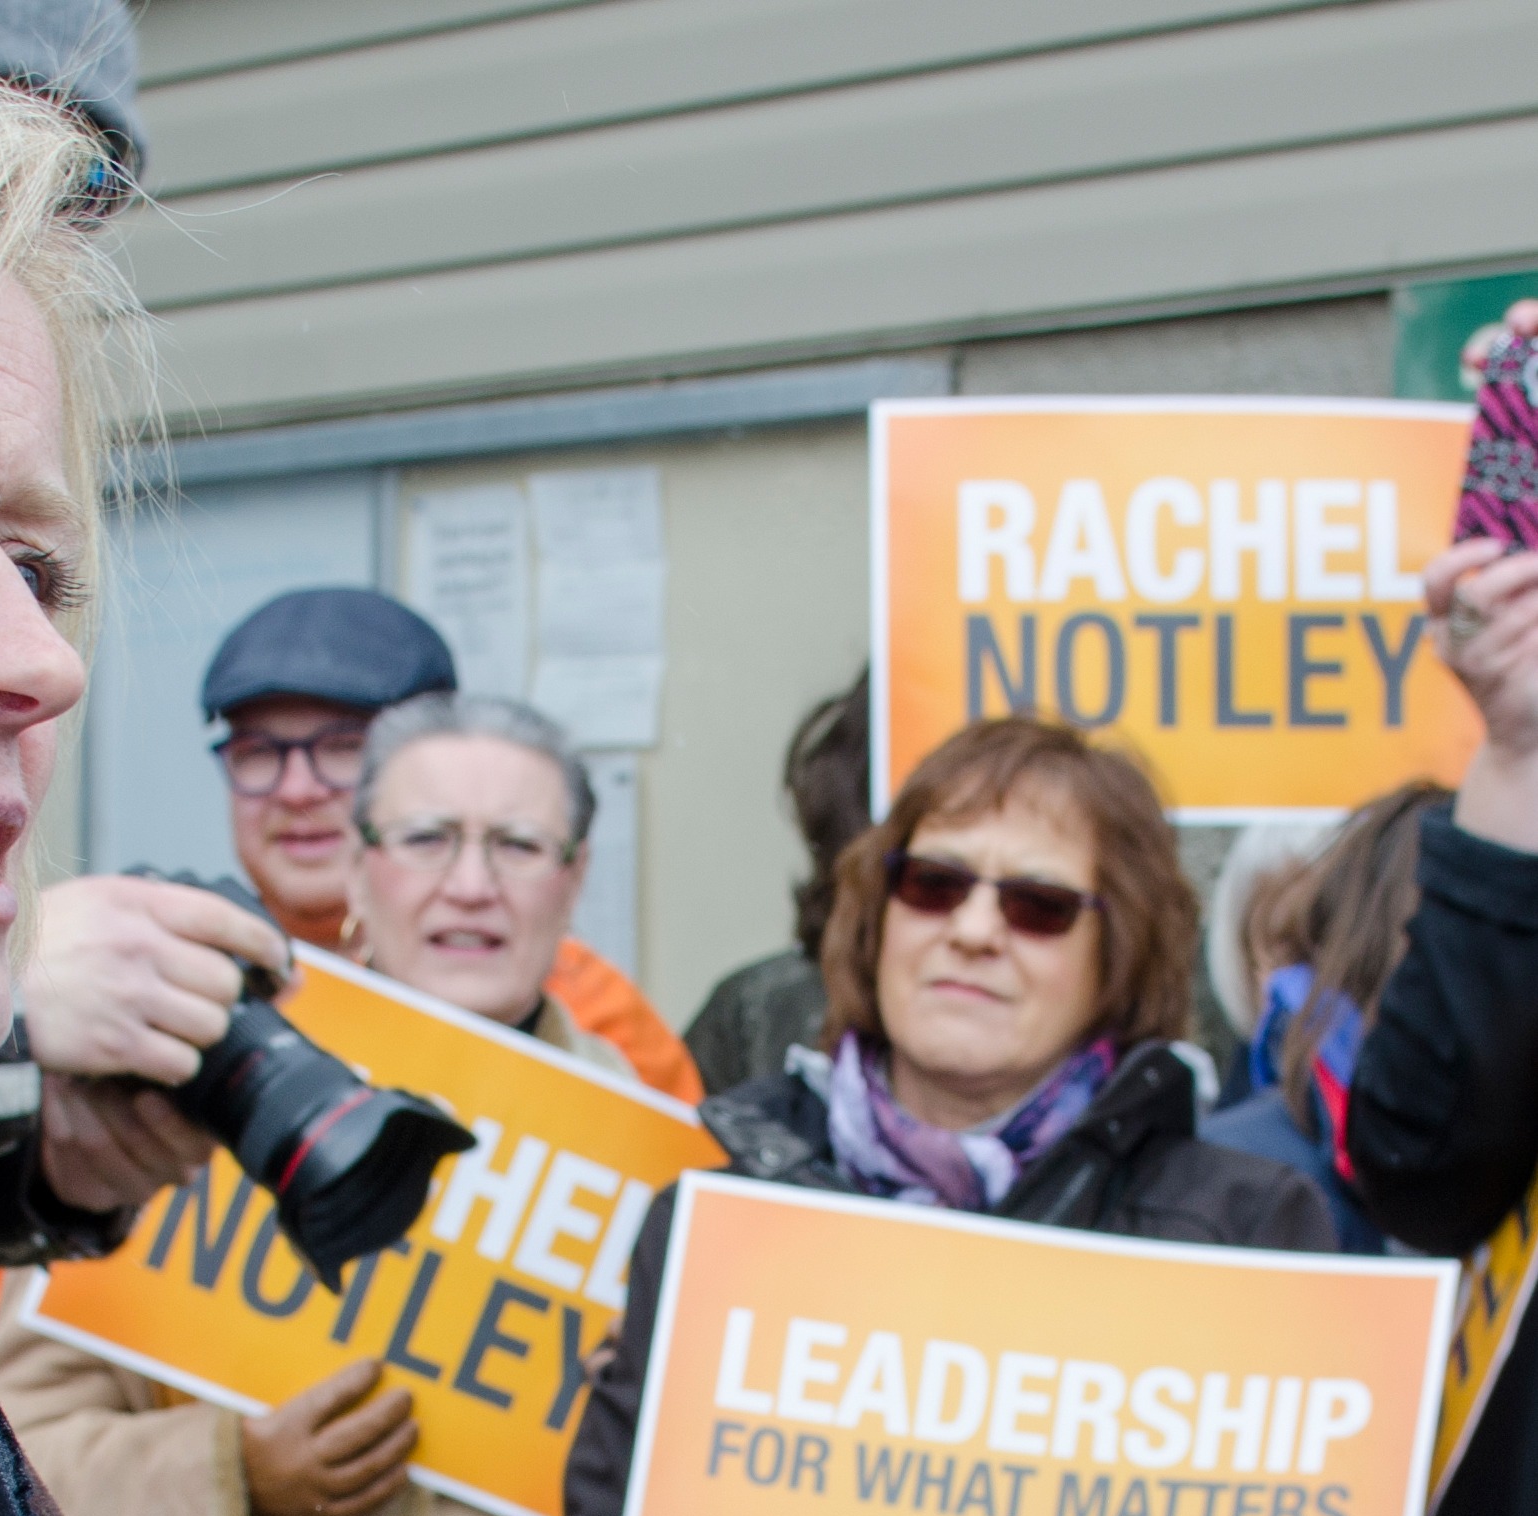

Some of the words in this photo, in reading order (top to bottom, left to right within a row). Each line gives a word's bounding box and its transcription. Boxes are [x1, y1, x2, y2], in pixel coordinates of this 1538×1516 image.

[958, 477, 1426, 604] RACHEL
[966, 612, 1431, 728] NOTLEY
[713, 1305, 1373, 1475] LEADERSHIP
[707, 1419, 831, 1496] FOR
